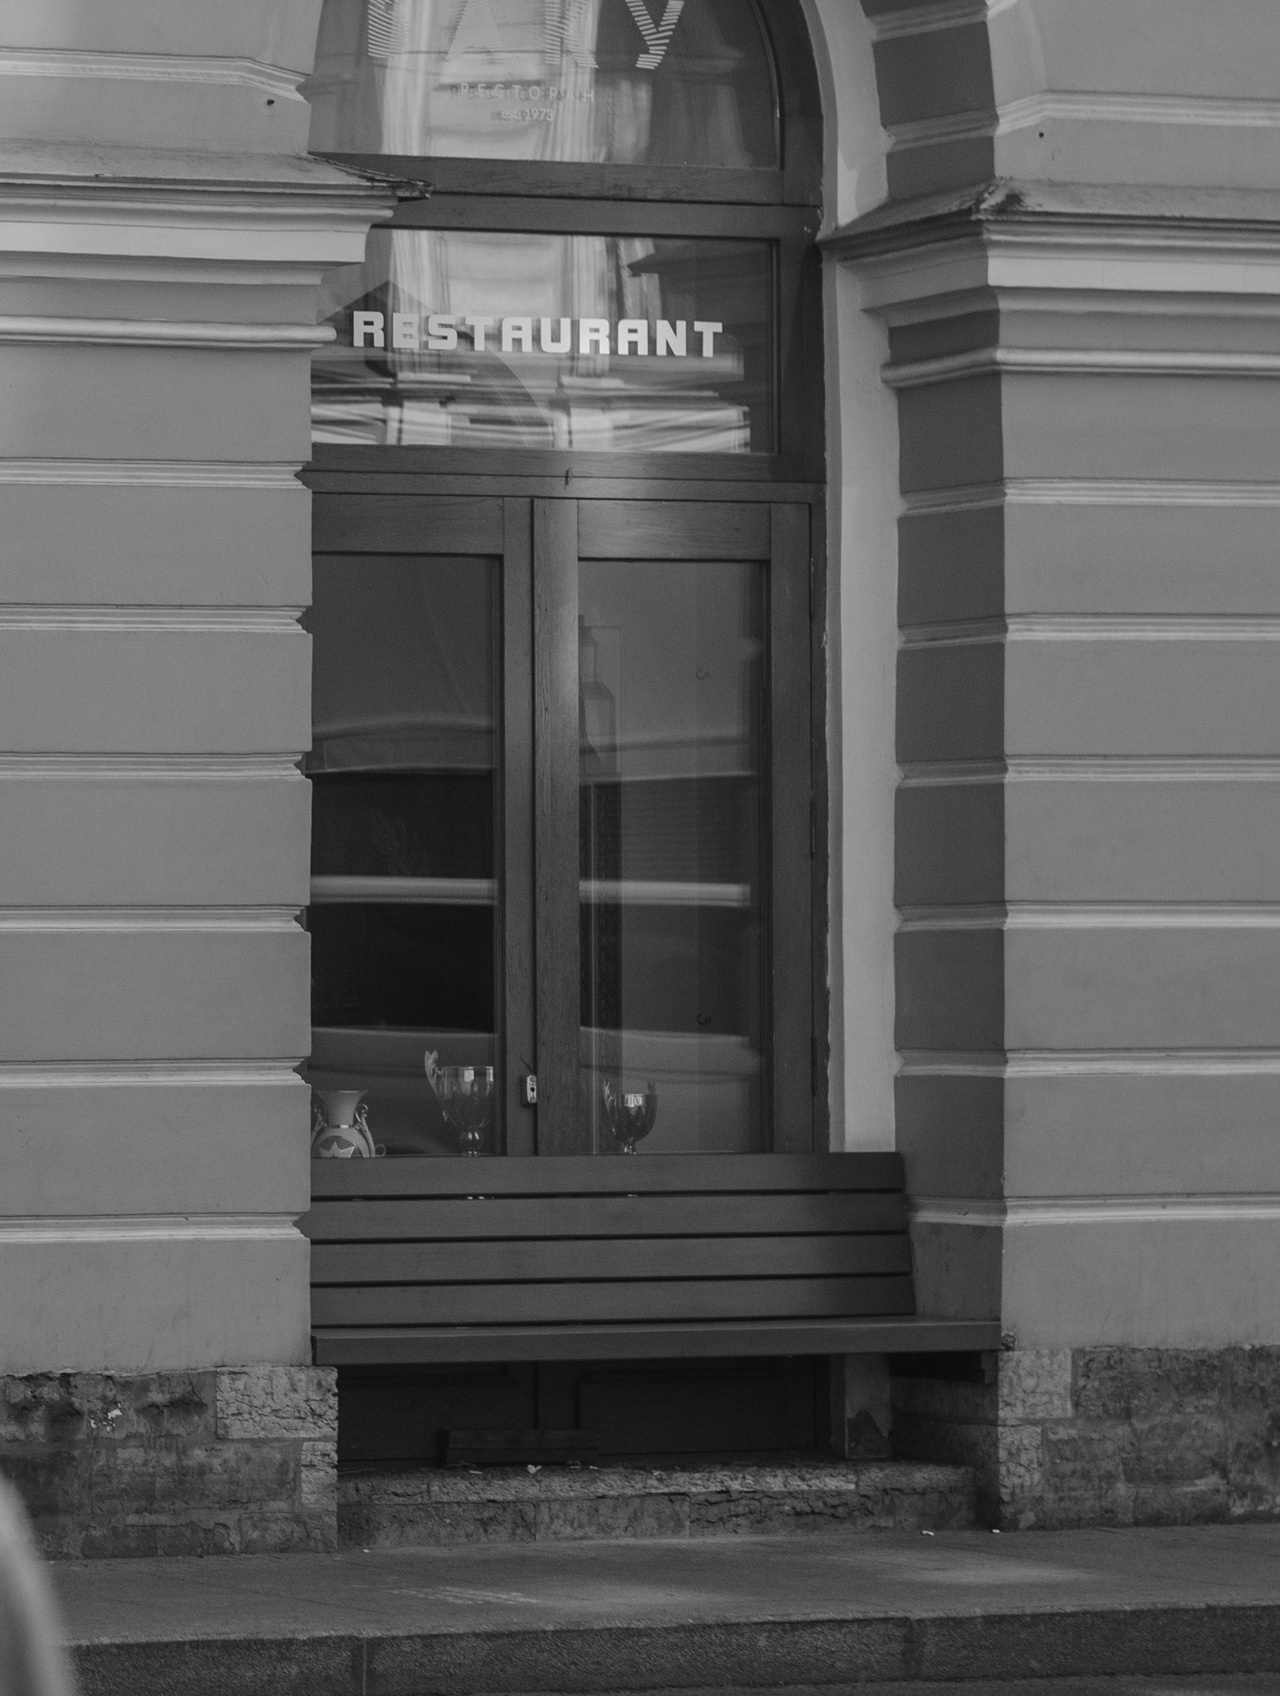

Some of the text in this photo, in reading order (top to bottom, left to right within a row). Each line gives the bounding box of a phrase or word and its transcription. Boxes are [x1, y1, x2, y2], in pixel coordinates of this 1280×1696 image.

[460, 83, 594, 102] РЕСТОРАН
[525, 109, 554, 121] 1973
[353, 311, 722, 358] RESTAURANT
